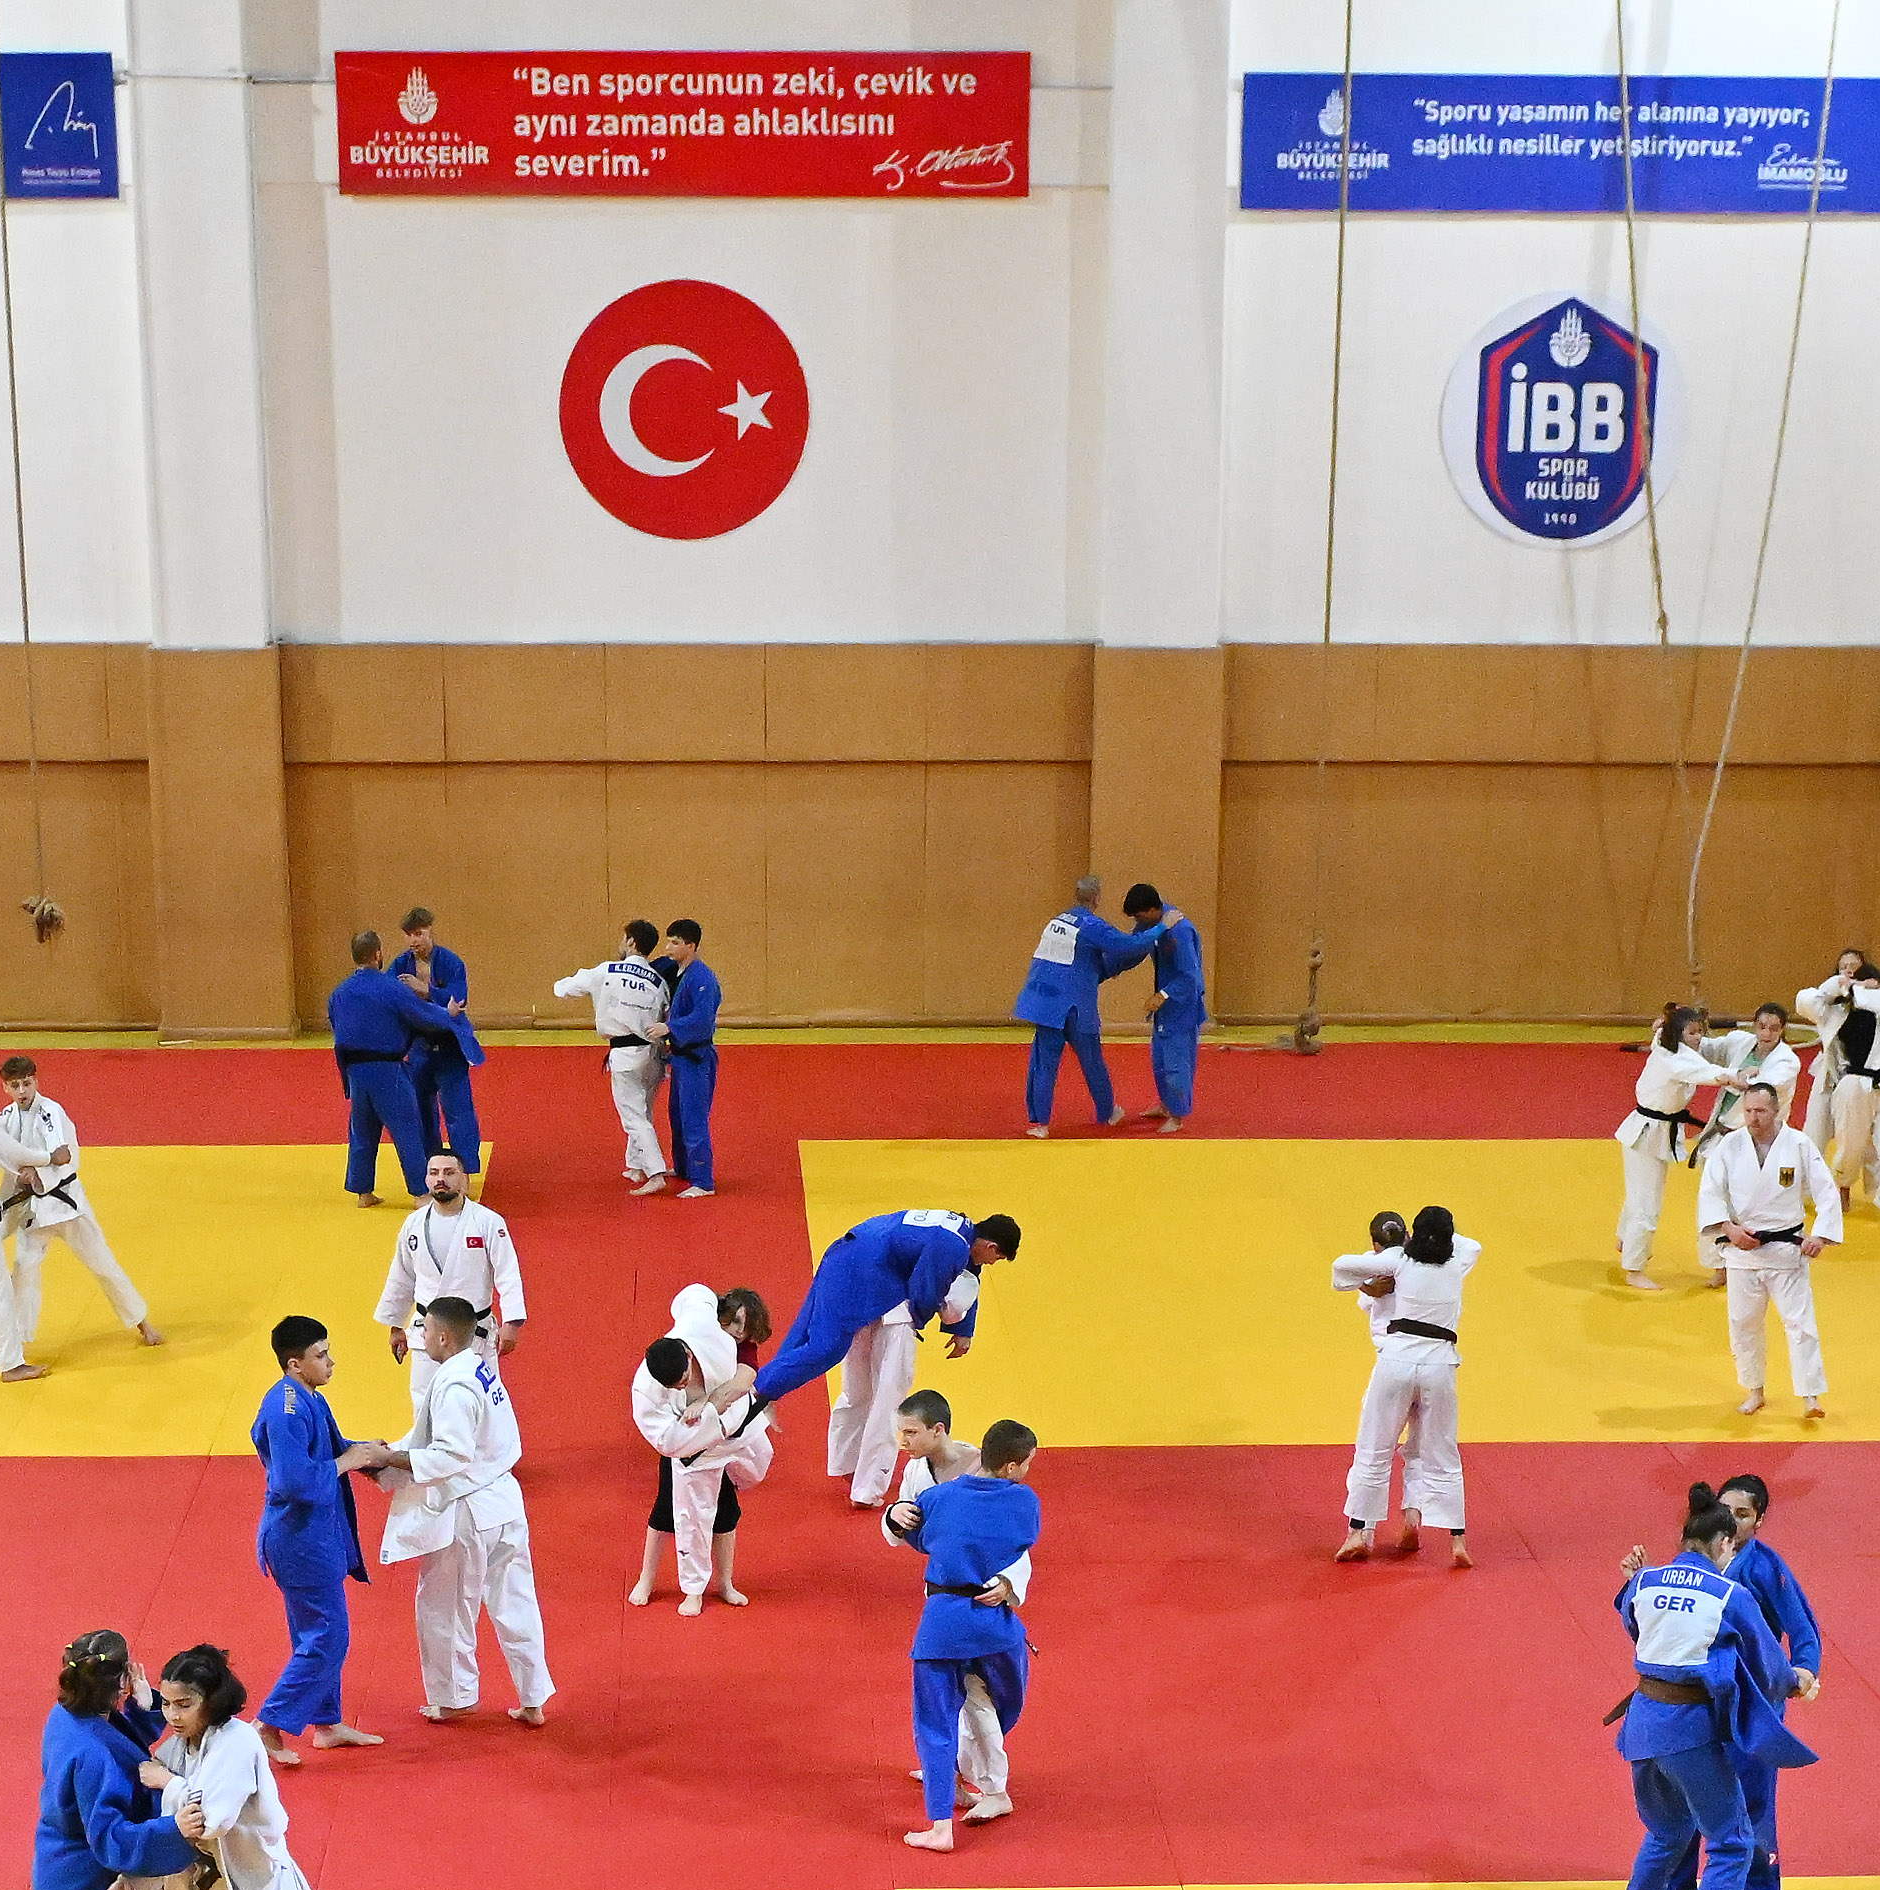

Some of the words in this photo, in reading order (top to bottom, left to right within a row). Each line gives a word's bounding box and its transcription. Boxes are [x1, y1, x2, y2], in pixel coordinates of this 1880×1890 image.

[513, 67, 590, 96] “Ben
[599, 73, 764, 103] sporcunun
[772, 66, 845, 100] zeki,
[854, 66, 934, 100] çevik
[942, 73, 977, 95] ve
[513, 114, 577, 143] aynı
[586, 107, 725, 136] zamanda
[734, 107, 895, 136] ahlaklısını
[1412, 98, 1492, 126] “Sporu
[1496, 103, 1589, 126] yaşamın
[1638, 101, 1719, 123] alanına
[1723, 106, 1810, 129] yayıyor;
[350, 140, 490, 169] BÜYÜKŞEHİR
[1412, 133, 1494, 160] sağlıklı
[1498, 133, 1586, 156] nesiller
[1590, 134, 1754, 161] yetştiriyoruz.”
[515, 148, 667, 177] severim.”
[1507, 362, 1625, 453] İBB
[1538, 457, 1589, 477] SPOR
[1525, 476, 1601, 501] KULÜBÜ
[621, 978, 646, 992] TUR
[492, 1387, 505, 1406] GE
[1661, 1569, 1704, 1587] URBAN
[1653, 1594, 1697, 1613] GER
